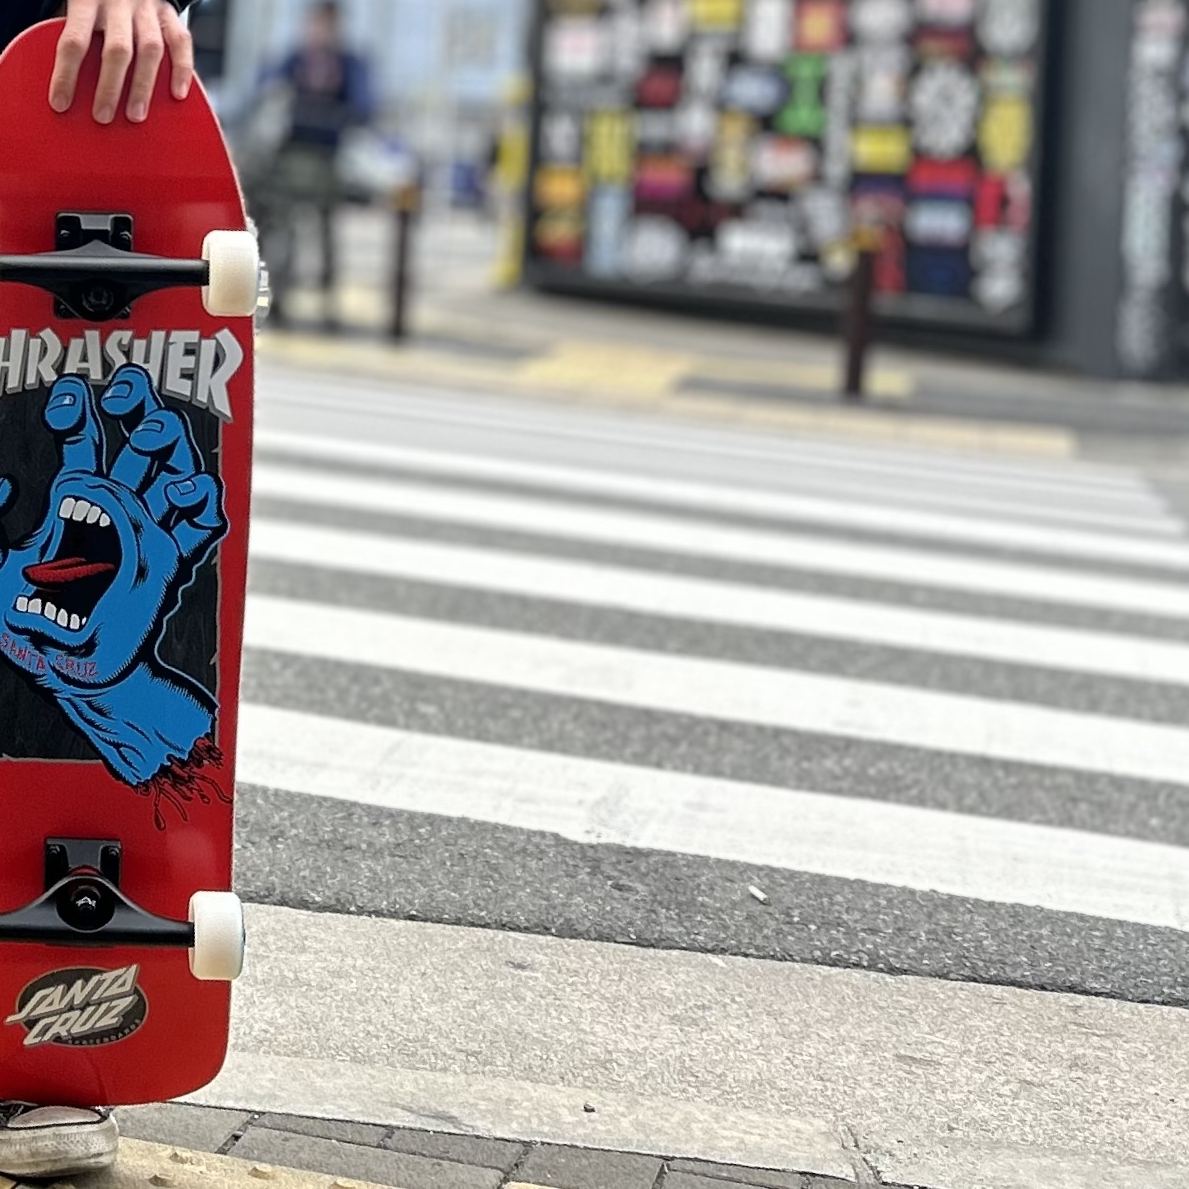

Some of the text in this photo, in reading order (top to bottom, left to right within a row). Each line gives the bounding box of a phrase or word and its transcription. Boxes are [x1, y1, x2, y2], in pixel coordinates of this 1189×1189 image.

[54, 653, 99, 678] CRUZ
[4, 964, 141, 1025] SANTA
[22, 994, 140, 1048] CRUZ
